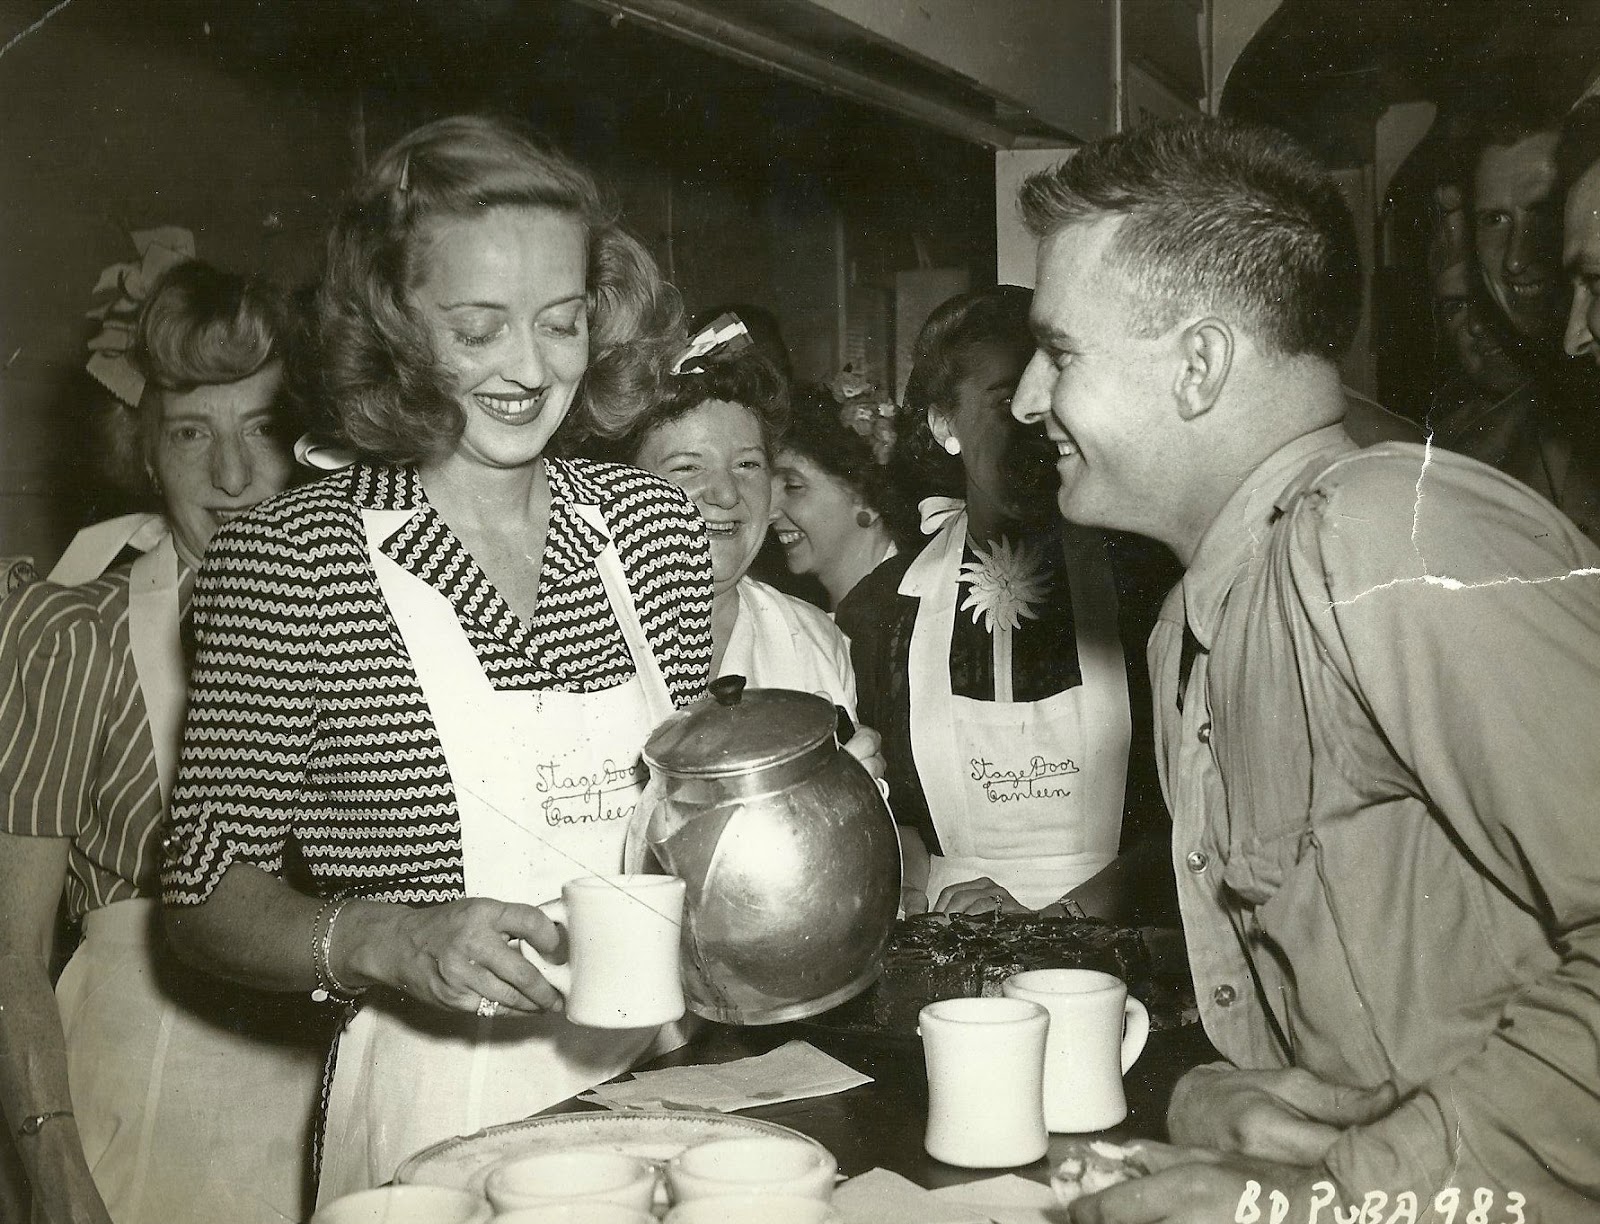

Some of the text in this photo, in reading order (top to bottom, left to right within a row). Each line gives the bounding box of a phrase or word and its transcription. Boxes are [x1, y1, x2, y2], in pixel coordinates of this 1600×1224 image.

[536, 760, 602, 803] Stage
[970, 755, 1080, 789] Stage Door
[983, 778, 1071, 803] Canteen
